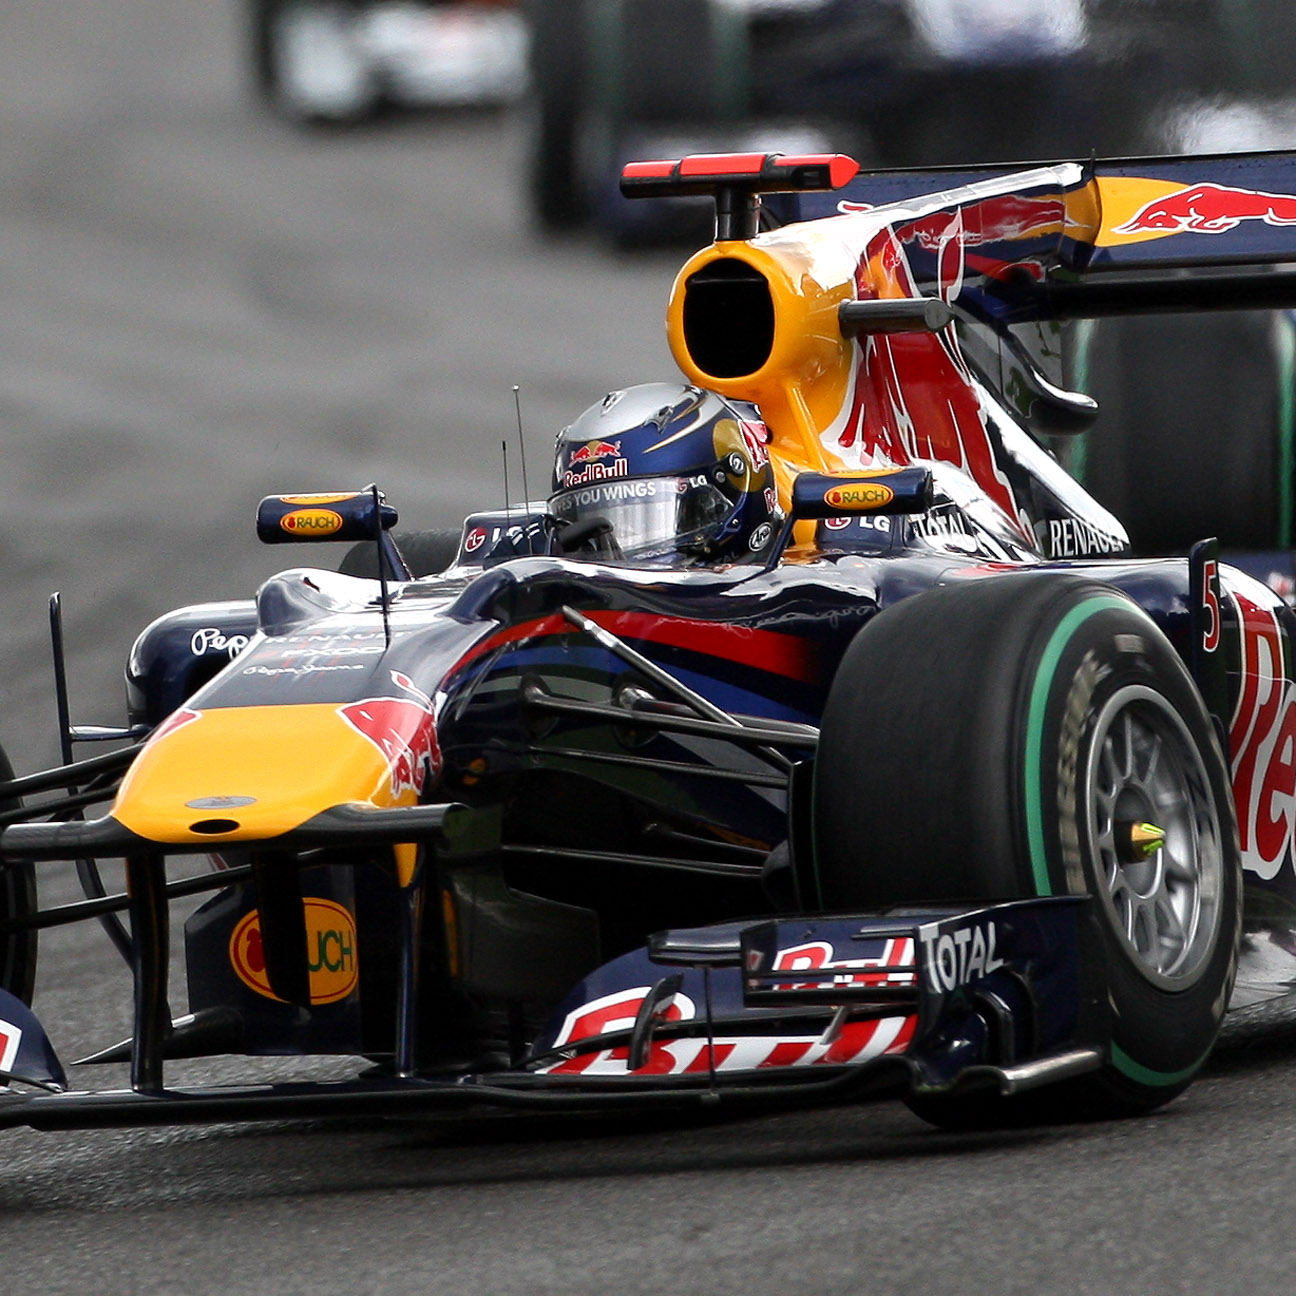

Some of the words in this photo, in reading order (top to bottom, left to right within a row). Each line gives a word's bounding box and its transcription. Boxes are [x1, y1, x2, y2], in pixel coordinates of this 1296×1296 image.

[592, 457, 628, 480] Bull
[574, 488, 601, 506] YOU
[603, 481, 657, 501] WINGS
[842, 490, 885, 503] RAUCH
[296, 516, 335, 529] RAUCH
[859, 515, 891, 533] LG
[307, 929, 353, 972] UCH
[918, 920, 1005, 994] TOTAL
